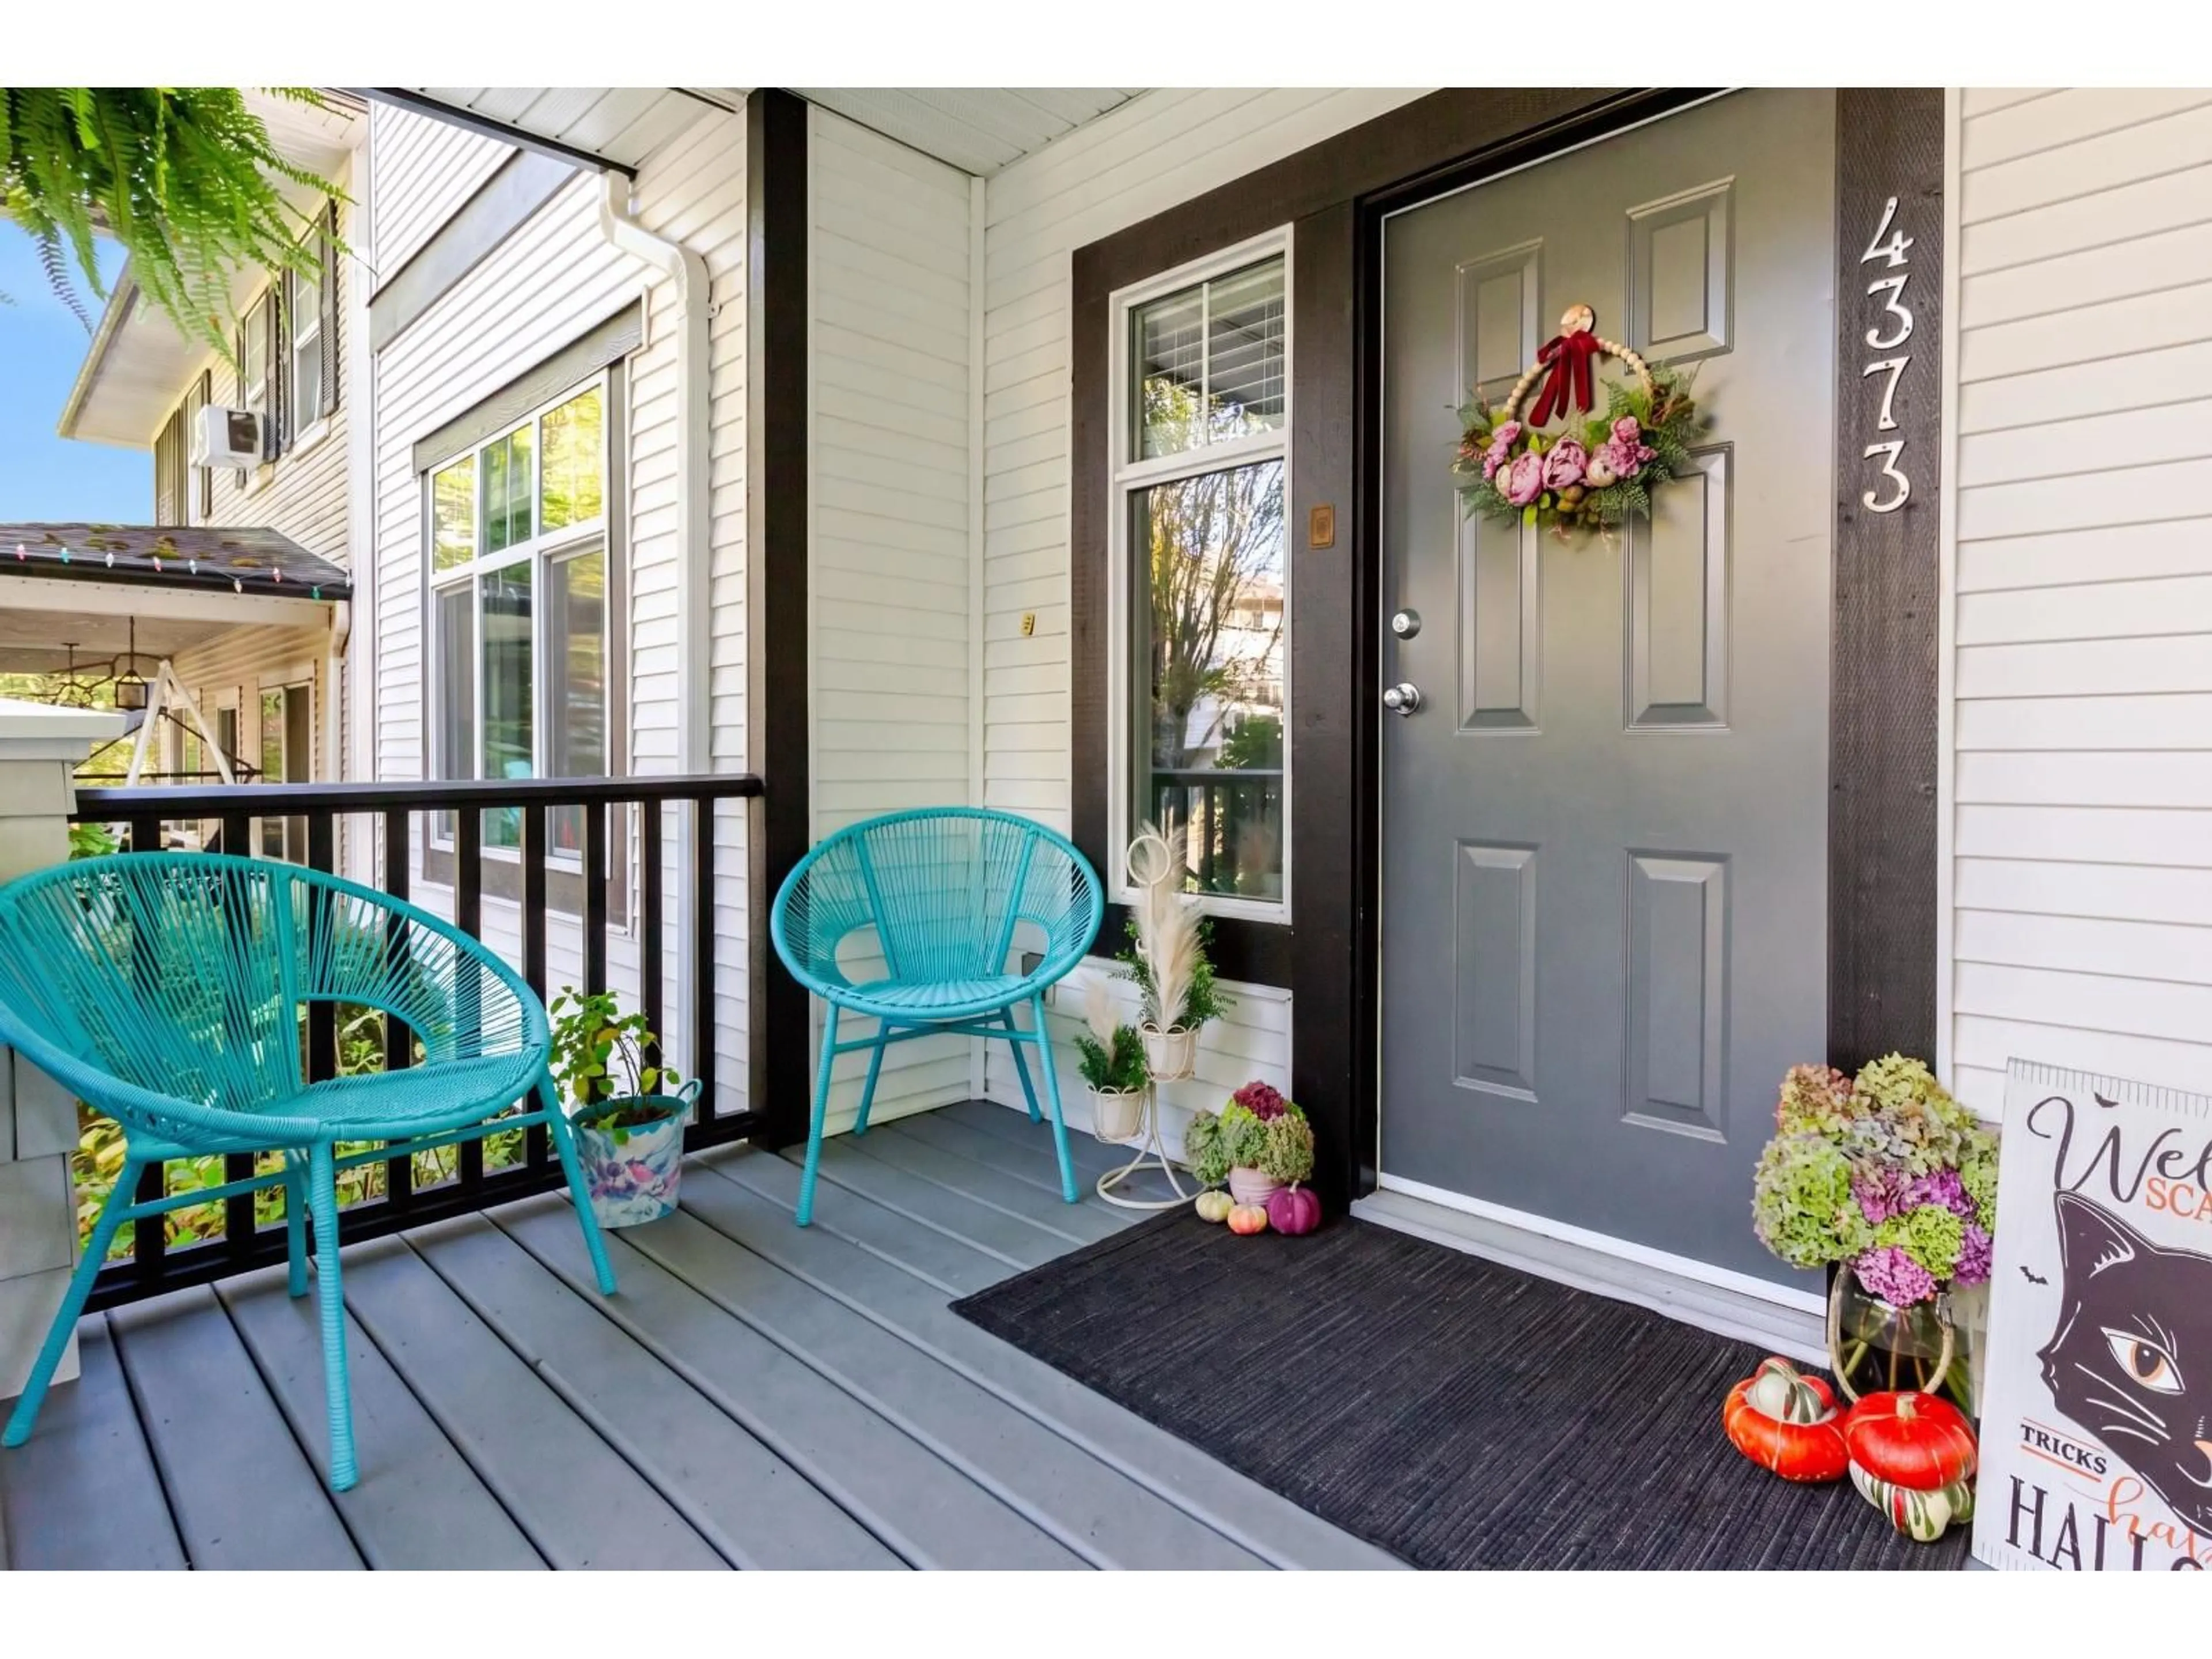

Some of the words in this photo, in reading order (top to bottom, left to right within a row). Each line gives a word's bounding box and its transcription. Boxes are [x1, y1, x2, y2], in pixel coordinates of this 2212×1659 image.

[1861, 196, 1915, 512] 4373
[2021, 1424, 2107, 1475] TRICKS
[2005, 1475, 2203, 1571] HALL
